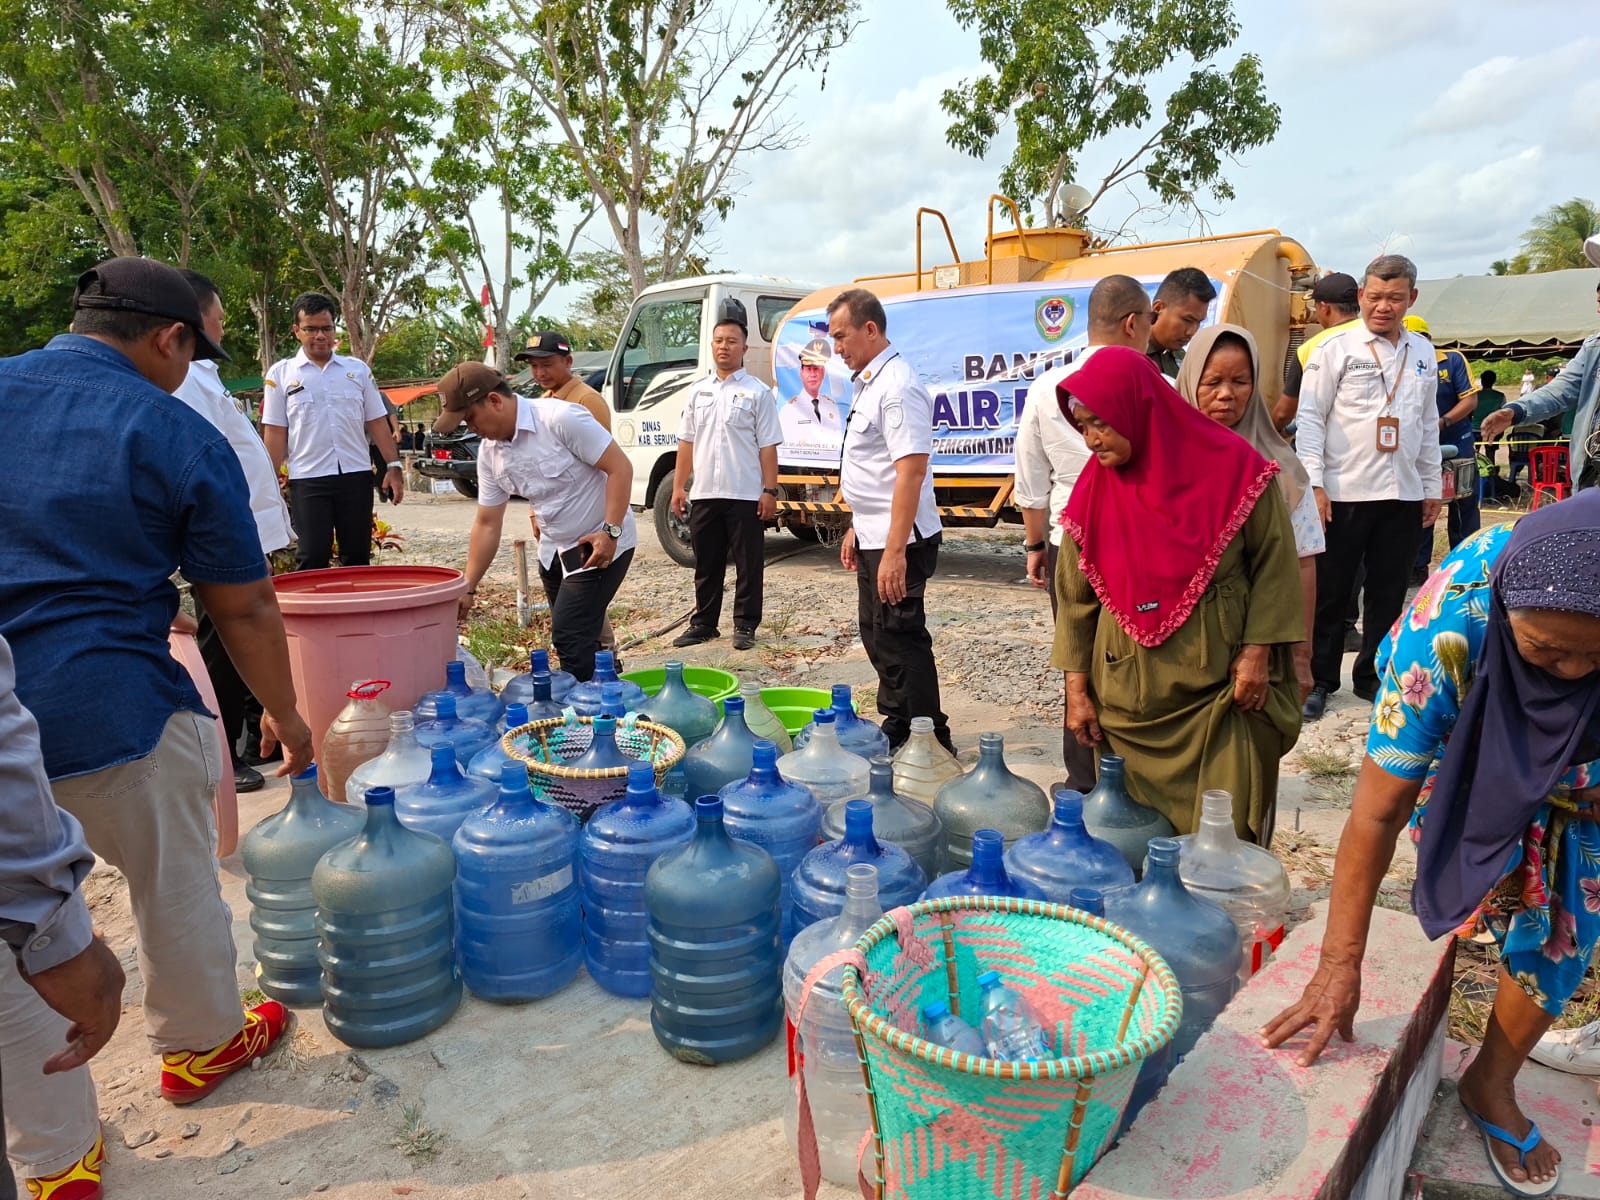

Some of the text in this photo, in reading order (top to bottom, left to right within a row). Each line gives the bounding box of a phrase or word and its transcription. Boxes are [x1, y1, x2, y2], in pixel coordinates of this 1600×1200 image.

[932, 389, 1000, 428] AIR
[642, 421, 661, 432] DINAS
[654, 434, 680, 446] SERUYA
[931, 437, 1014, 454] PEMERINTAH
